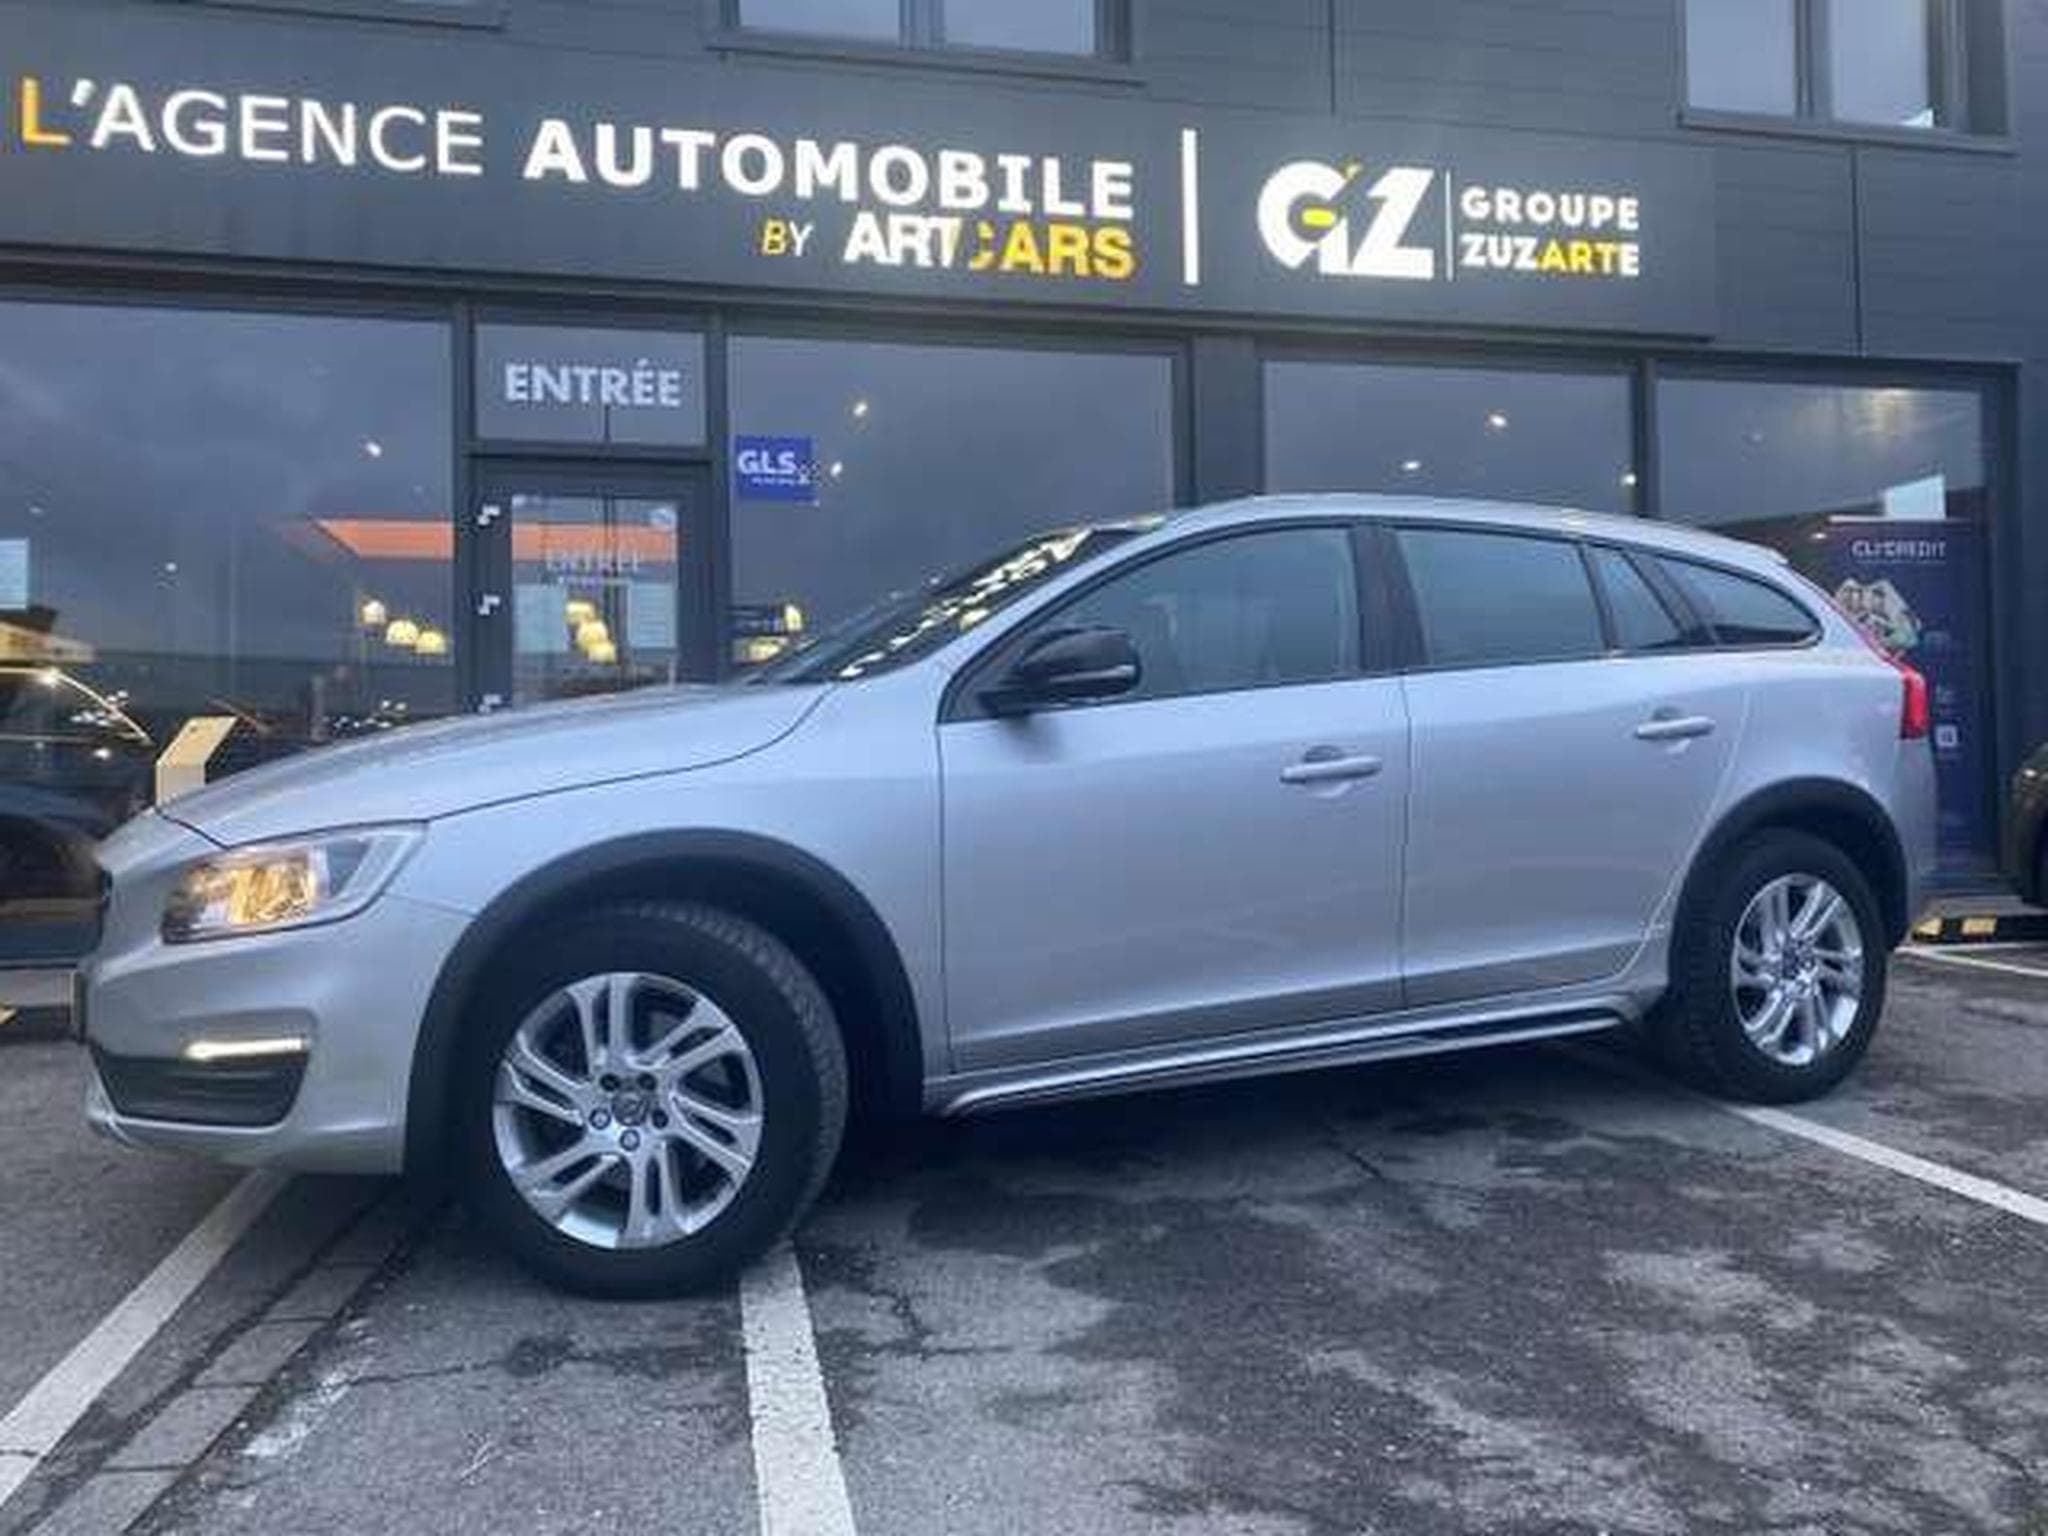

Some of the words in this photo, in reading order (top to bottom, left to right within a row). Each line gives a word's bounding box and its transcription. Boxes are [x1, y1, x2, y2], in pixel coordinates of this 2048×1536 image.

[20, 76, 484, 178] L'AGENCE
[522, 117, 1135, 222] AUTOMOBILE
[1460, 186, 1640, 230] GROUPE
[760, 218, 813, 257] BY
[1460, 233, 1640, 277] ZUZARTE
[504, 359, 681, 407] ENTRÉE
[737, 449, 797, 475] GLS
